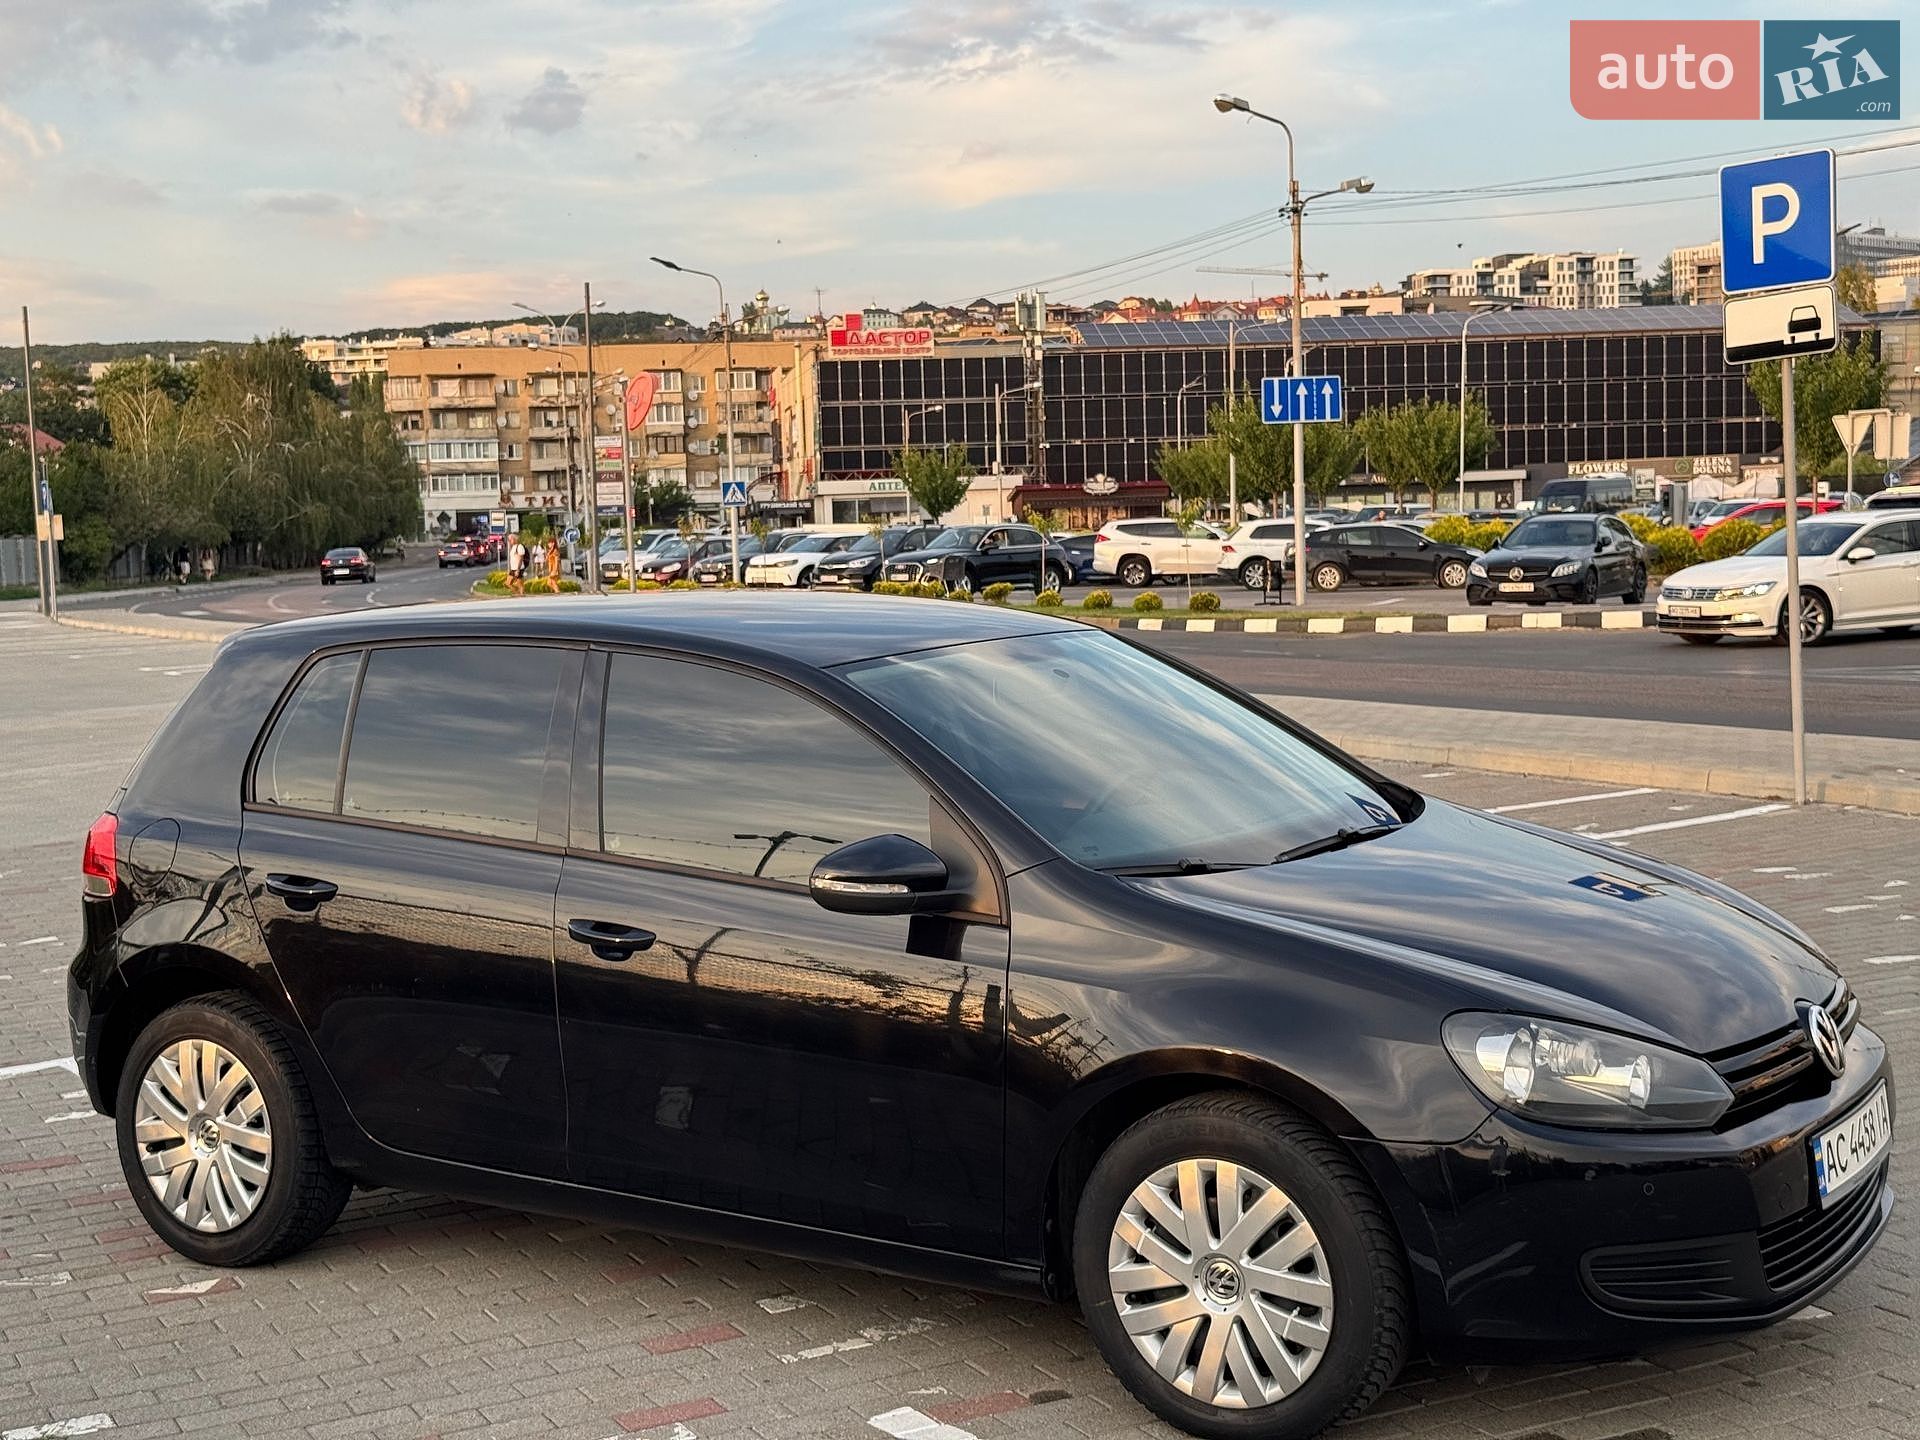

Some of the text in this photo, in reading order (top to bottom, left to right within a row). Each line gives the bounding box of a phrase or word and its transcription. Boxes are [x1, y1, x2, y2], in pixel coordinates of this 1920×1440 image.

[1751, 182, 1800, 265] P
[848, 330, 931, 347] ДАСТОР
[1567, 461, 1629, 475] FLOWERS
[1692, 457, 1732, 466] ZELENA
[1692, 465, 1733, 475] DOLYNA
[868, 481, 908, 492] АПТЕ
[1850, 1108, 1876, 1163] 4458
